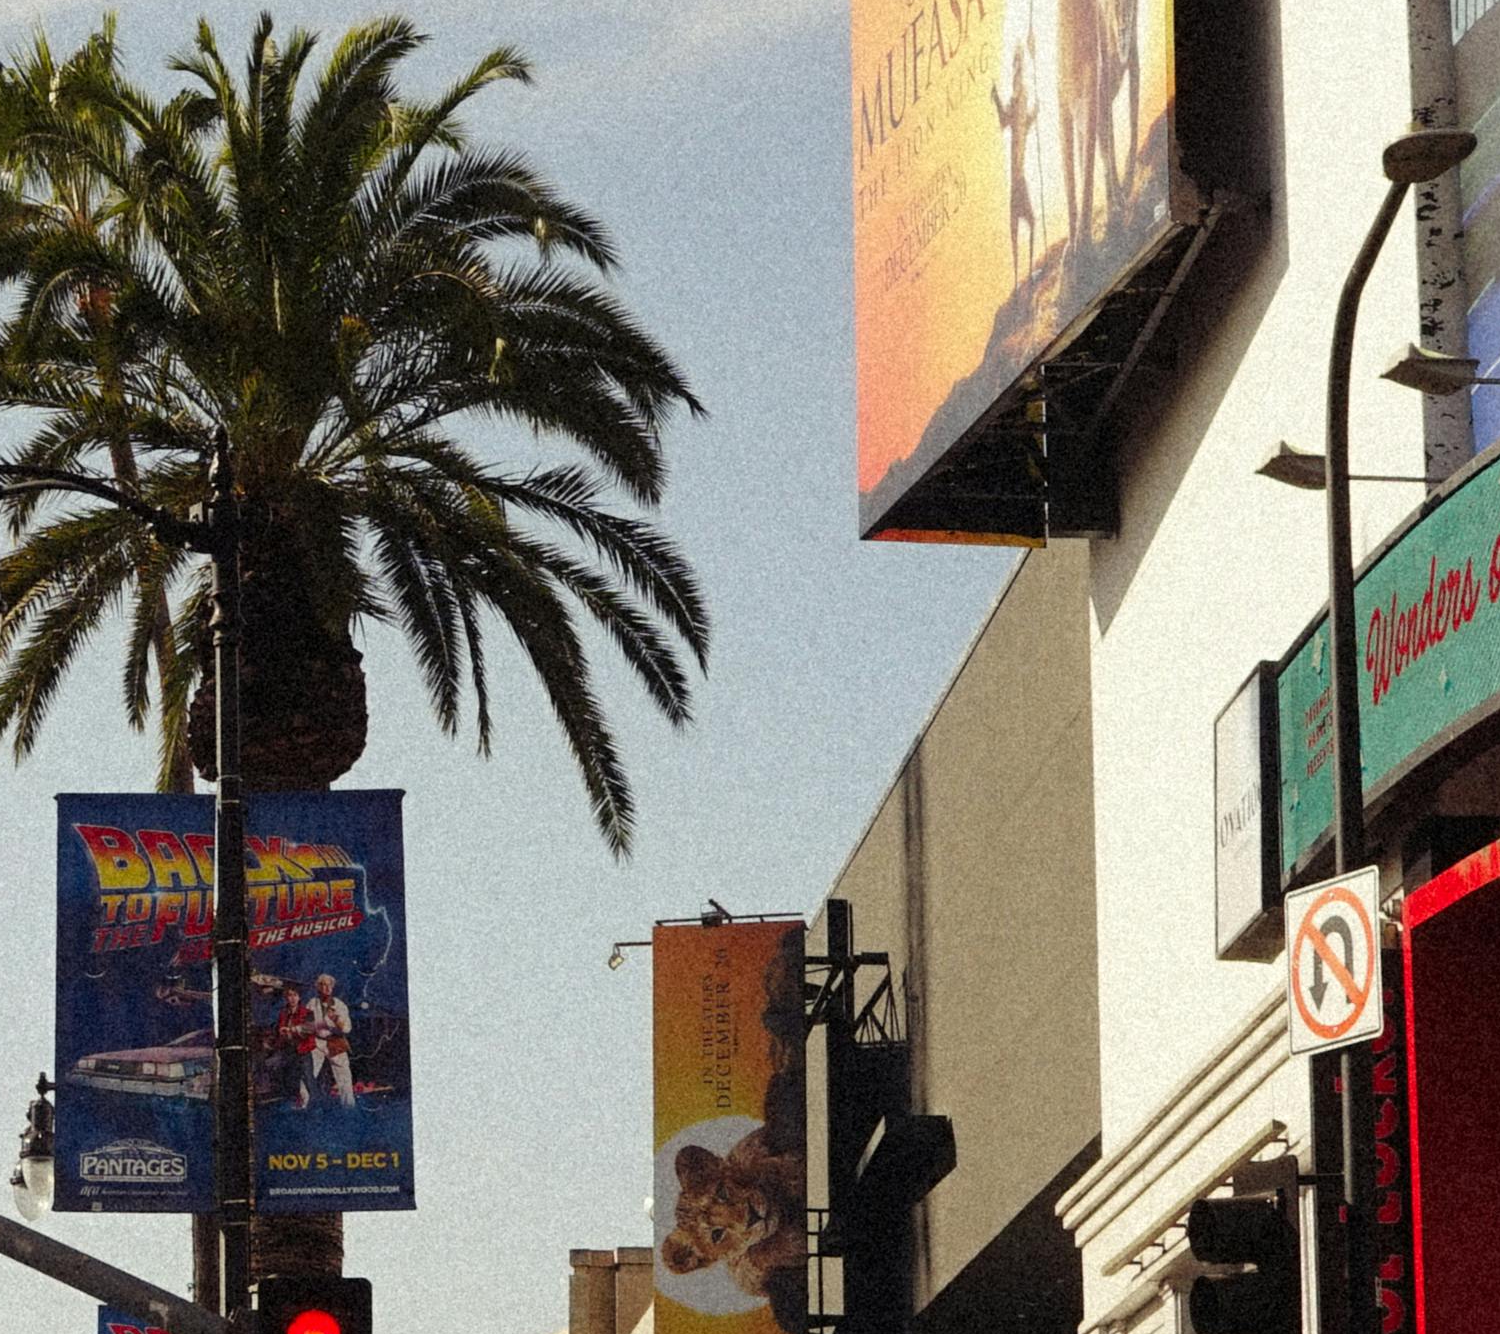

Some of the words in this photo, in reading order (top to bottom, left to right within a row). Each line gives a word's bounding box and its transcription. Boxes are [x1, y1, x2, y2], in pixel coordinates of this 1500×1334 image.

[1365, 556, 1481, 707] Wonders
[99, 893, 152, 924] TO
[151, 878, 356, 943] FUTURE
[256, 928, 286, 945] THE
[289, 915, 355, 939] MUSICAL
[715, 981, 732, 1108] DECEMBER
[83, 1157, 186, 1177] PANTAGES
[269, 1154, 310, 1171] NOV
[315, 1153, 327, 1169] 5
[347, 1152, 386, 1169] DEC
[391, 1151, 399, 1168] 1
